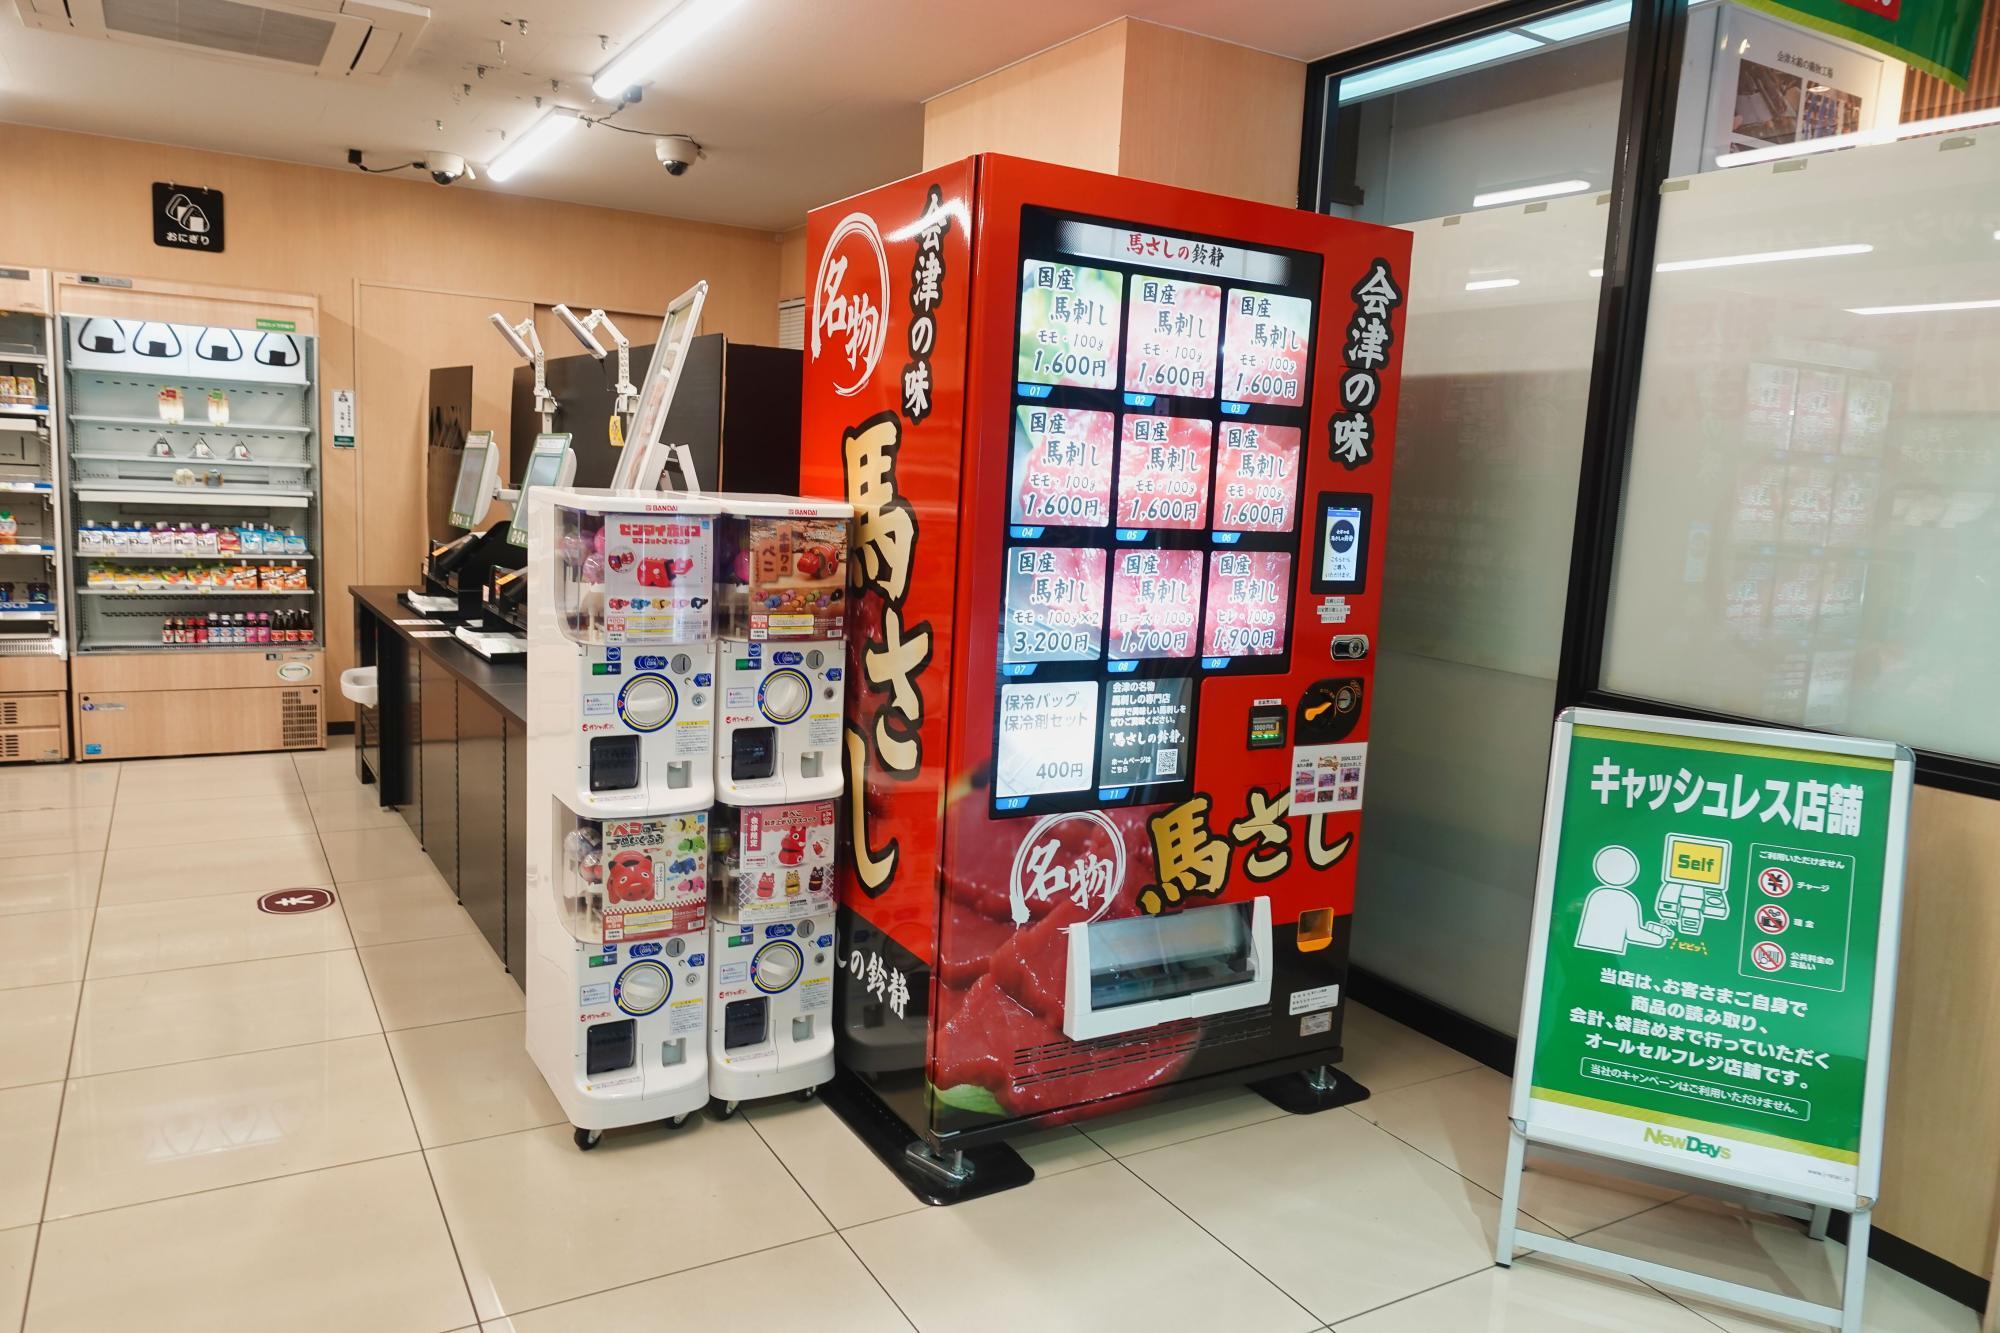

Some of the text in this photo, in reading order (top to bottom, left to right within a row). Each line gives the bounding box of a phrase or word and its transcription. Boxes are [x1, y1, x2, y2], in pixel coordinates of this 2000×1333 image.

[166, 231, 210, 245] おにぎり
[1126, 233, 1225, 268] 馬さしの鈴静
[1038, 266, 1074, 291] 国産
[905, 193, 947, 416] 会津の味
[1143, 282, 1176, 305] 国産
[820, 255, 879, 371] 名物
[1050, 296, 1107, 326] 馬刺し
[1241, 296, 1272, 318] 国産
[1154, 311, 1206, 339] 馬刺し
[1251, 323, 1299, 350] 馬刺し
[1033, 350, 1106, 377] 1,600円
[1138, 362, 1205, 388] 1,600円
[1334, 266, 1397, 463] 会津の味
[1029, 386, 1041, 396] 01
[1236, 373, 1297, 398] 1,600円
[1135, 395, 1146, 405] 02
[1231, 403, 1241, 413] 03
[1030, 412, 1065, 435] 国産
[1135, 420, 1167, 442] 国産
[1228, 429, 1258, 449] 国産
[1042, 440, 1100, 466] 馬刺し
[1146, 447, 1200, 472] 馬刺し
[1238, 455, 1287, 478] 馬刺し
[1025, 494, 1098, 517] 1,600円
[1130, 499, 1197, 521] 1,600円
[1222, 503, 1284, 524] 1,600円
[1022, 528, 1033, 538] 04
[1126, 530, 1137, 540] 05
[1222, 533, 1232, 542] 06
[1019, 552, 1055, 574] 国産
[1126, 554, 1159, 575] 国産
[1220, 555, 1251, 575] 国産
[1032, 578, 1088, 604] 馬刺し
[1137, 580, 1188, 604] 馬刺し
[1230, 580, 1278, 604] 馬刺し
[1014, 630, 1089, 653] 3,200円
[1120, 630, 1187, 652] 1,700円
[1214, 628, 1274, 648] 1,900円
[845, 421, 929, 888] 馬さし
[1118, 661, 1129, 671] 08
[1211, 657, 1222, 667] 09
[1014, 665, 1025, 674] 07
[1005, 691, 1079, 712] 保冷バッグ
[1004, 712, 1088, 732] 保冷剤セット
[1036, 761, 1083, 779] 400円
[1111, 756, 1151, 766] ホームページは
[1111, 765, 1128, 774] こちら
[1007, 799, 1018, 808] 10
[1109, 790, 1119, 799] 11
[1591, 757, 1864, 837] キャッシュレス店舗
[1141, 792, 1350, 914] 馬さし
[1677, 854, 1714, 872] Self
[1759, 851, 1845, 869] ご利用いただけません
[1025, 839, 1114, 910] 名物
[1600, 967, 1808, 1019] 当店は、お客さまご自身で
[1631, 996, 1769, 1034] 商品の読み取り、
[1569, 1007, 1830, 1069] 会計、袋詰めまで行っていただく
[1585, 1033, 1808, 1089] オールセルフレジ店舗です。
[1590, 1063, 1799, 1115] 当社のキャンペーンはご利用いただけません。
[1643, 1127, 1732, 1160] NewDays
